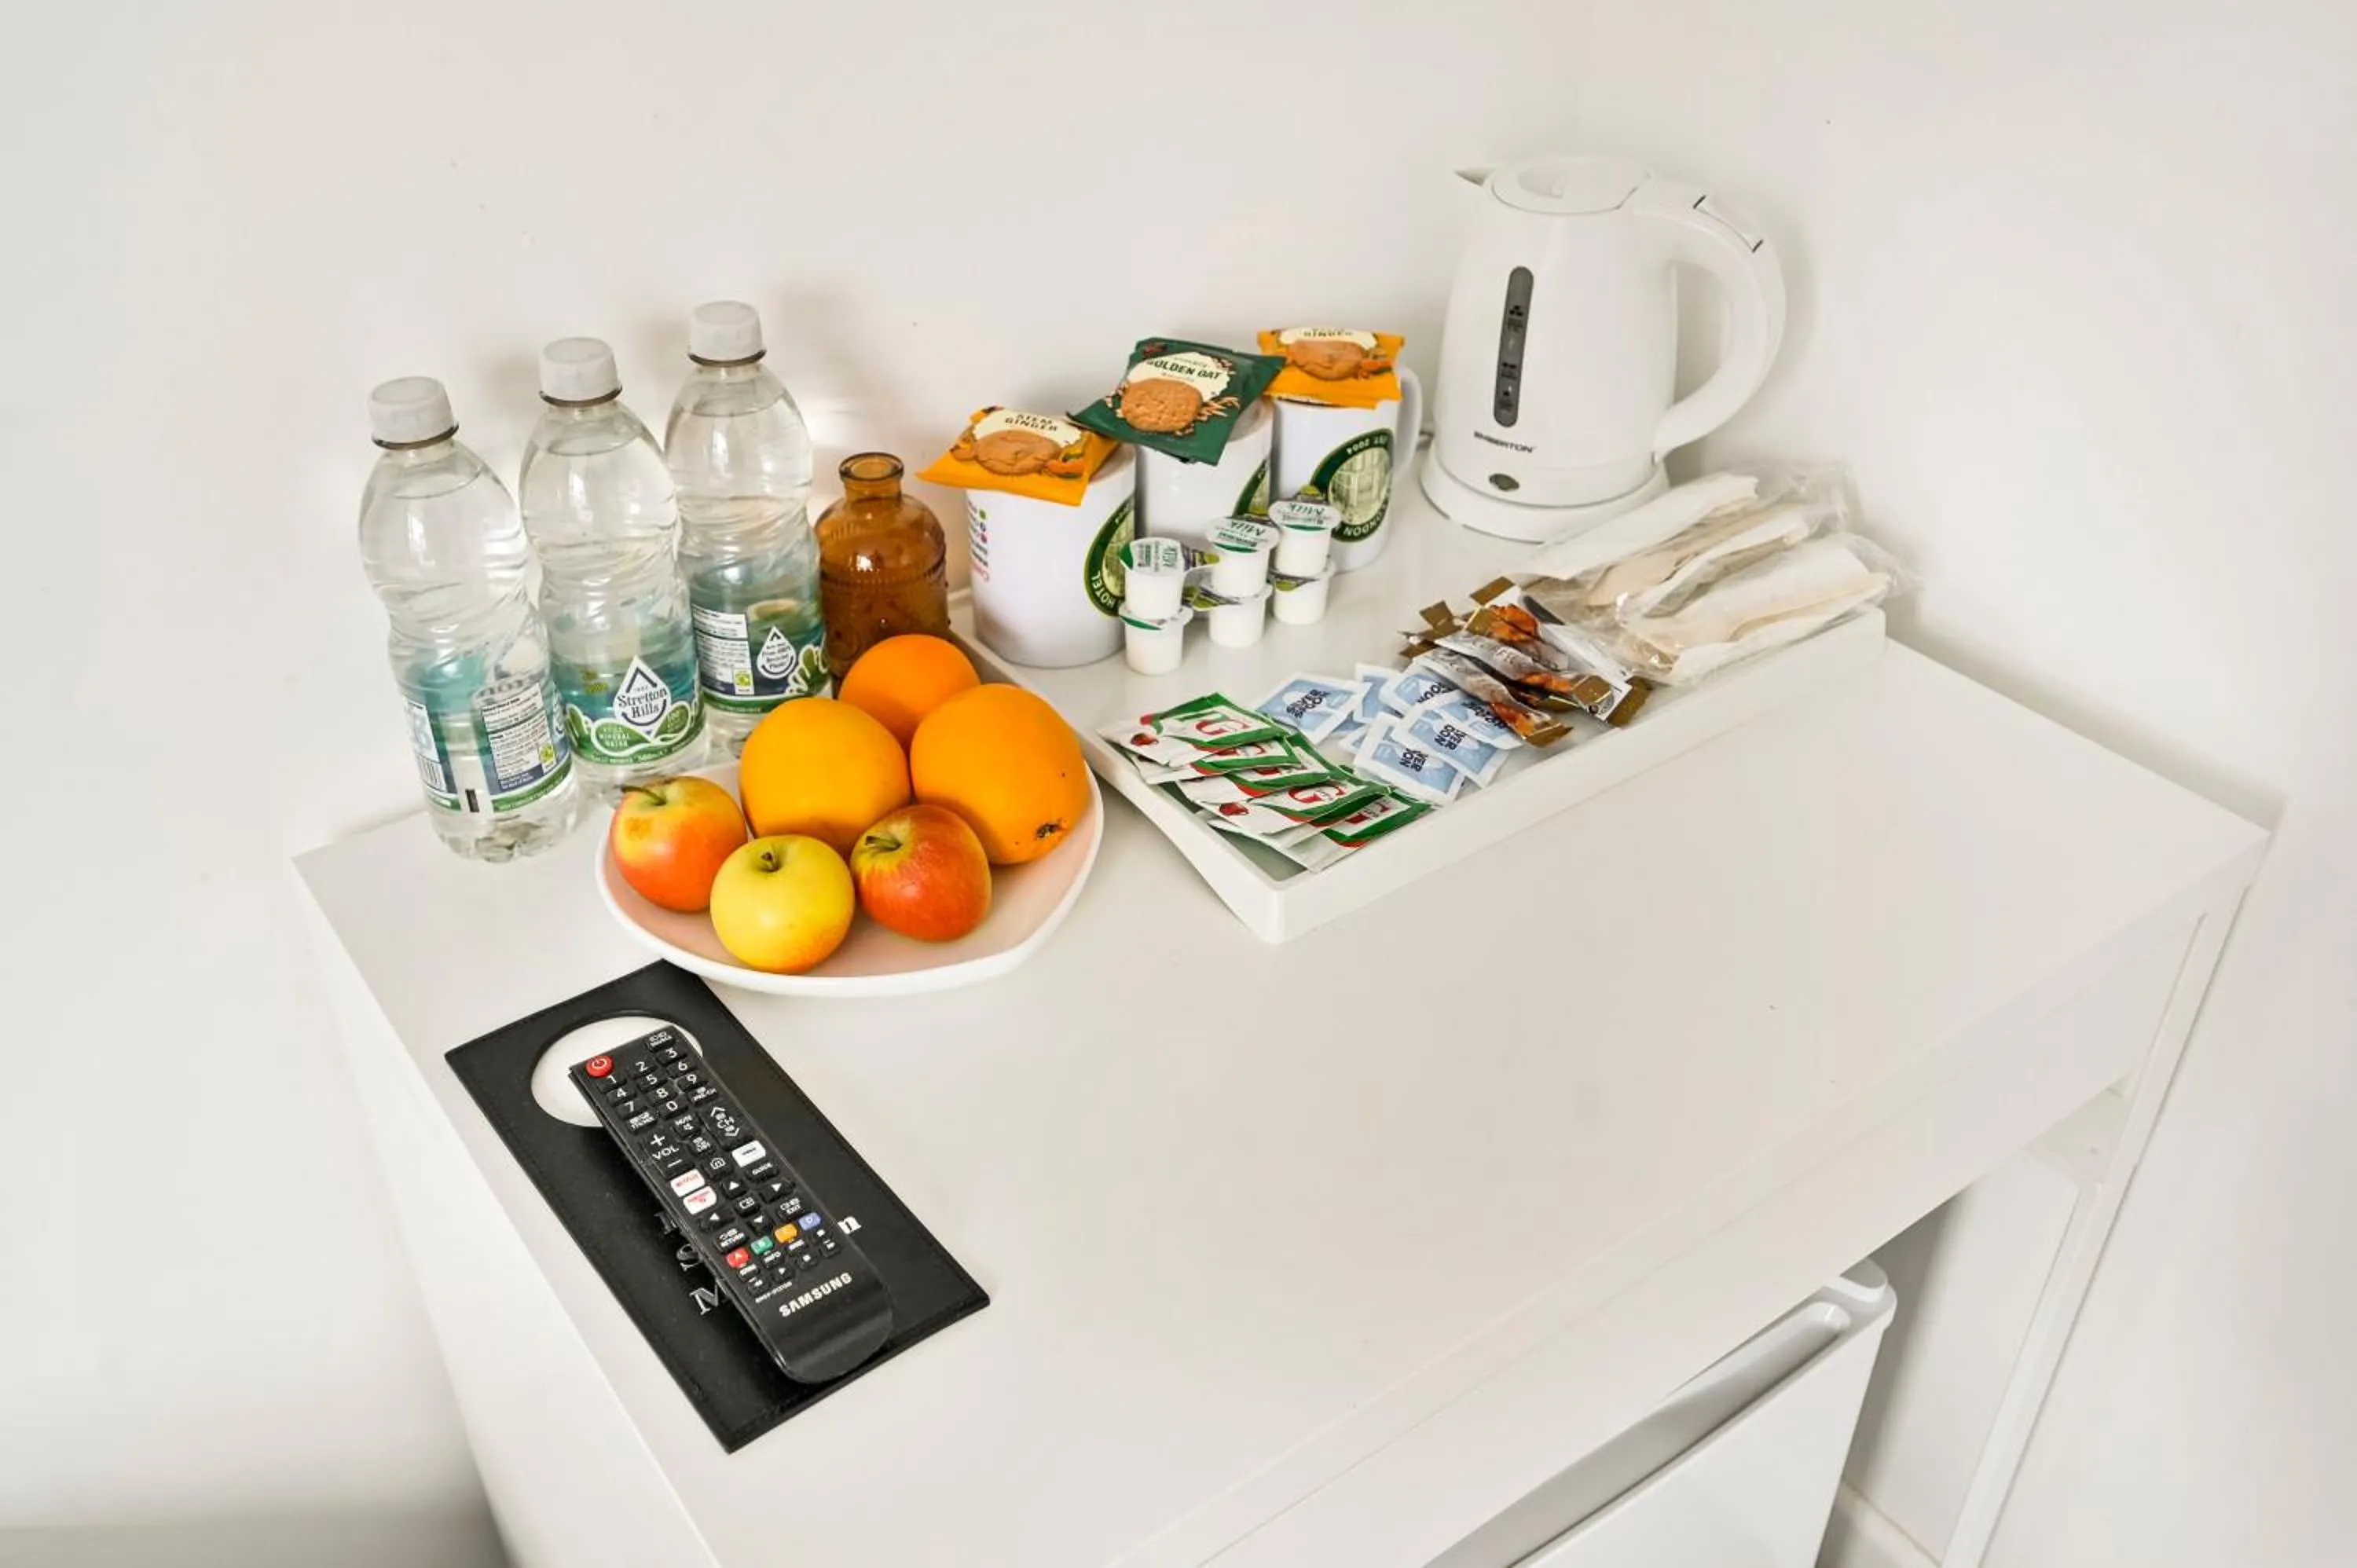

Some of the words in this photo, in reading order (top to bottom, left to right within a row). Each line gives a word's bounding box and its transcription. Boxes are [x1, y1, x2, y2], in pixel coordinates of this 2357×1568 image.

[1197, 370, 1223, 380] OAT
[617, 687, 668, 708] Stretton
[631, 703, 660, 719] Hills
[665, 1047, 678, 1058] 3
[636, 1061, 648, 1072] 2
[678, 1061, 688, 1071] 6
[607, 1075, 617, 1083] 1
[646, 1074, 658, 1085] 5
[686, 1074, 698, 1084] 9
[617, 1087, 627, 1097] 4
[656, 1088, 668, 1098] 8
[624, 1101, 634, 1112] 7
[665, 1101, 678, 1111] 0
[651, 1145, 680, 1160] VOL
[778, 1272, 853, 1318] SAMSUNG
